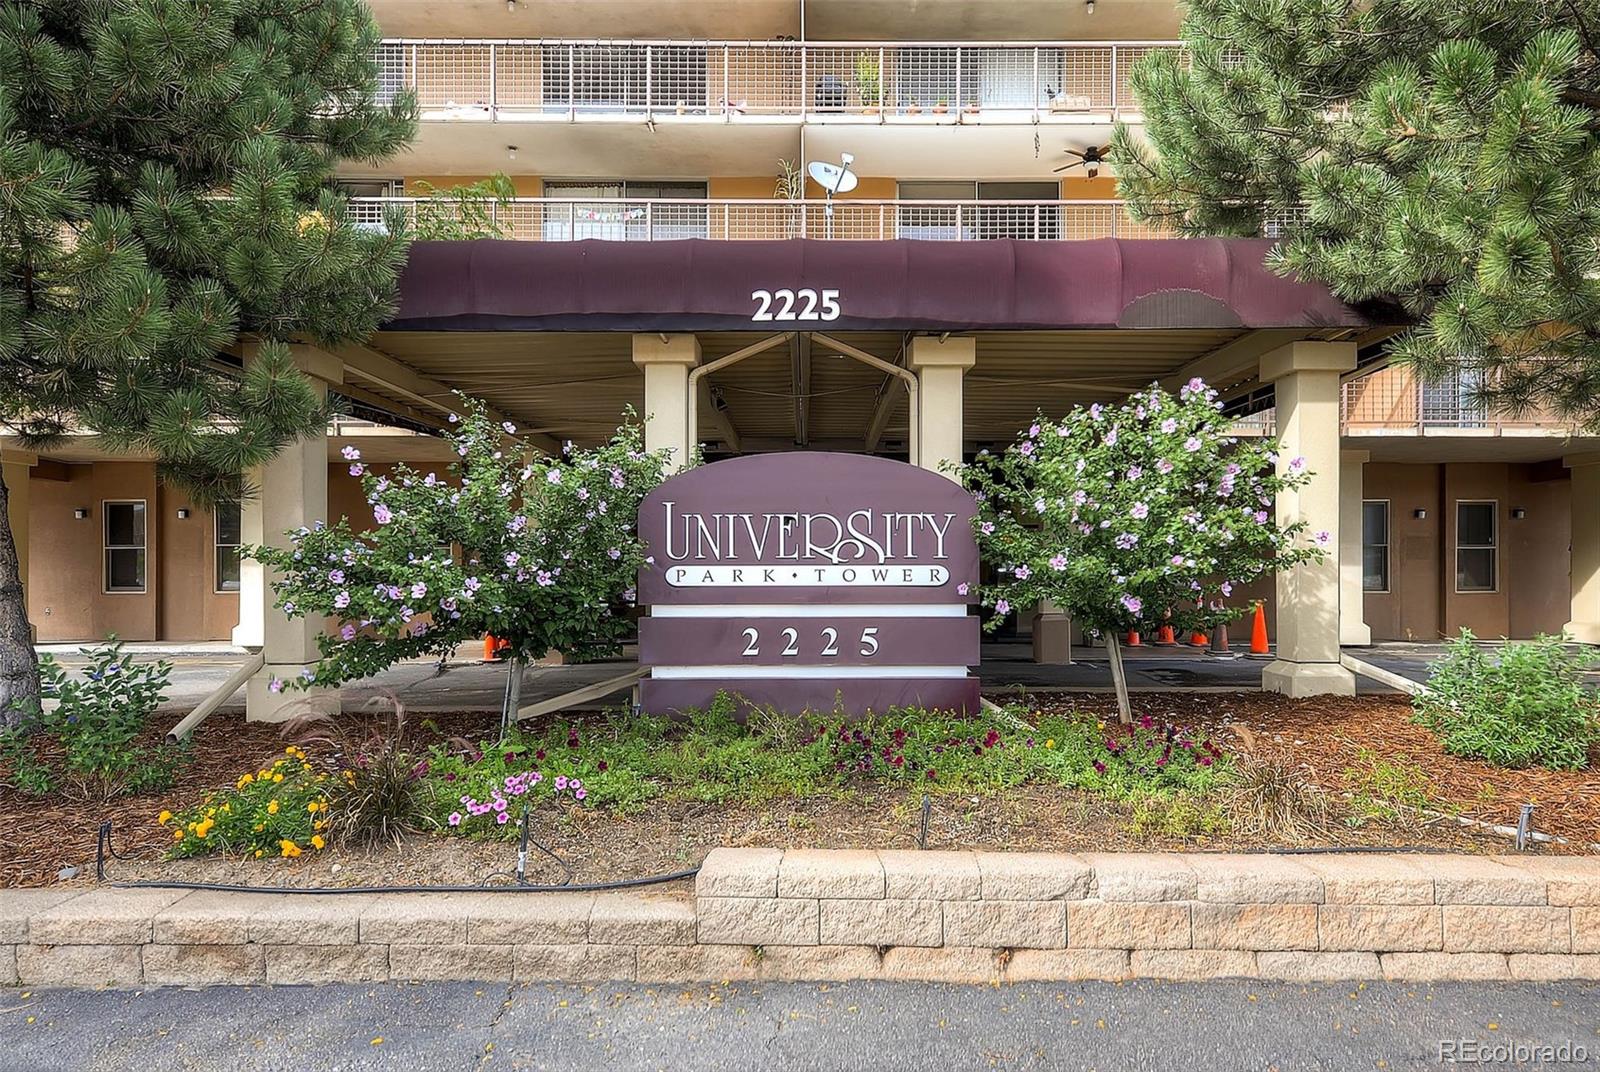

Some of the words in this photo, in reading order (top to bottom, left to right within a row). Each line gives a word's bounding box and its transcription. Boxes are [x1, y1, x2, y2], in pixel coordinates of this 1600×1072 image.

[751, 288, 841, 321] 2225
[662, 501, 957, 565] UNIVERSITY
[676, 568, 776, 583] PARK
[815, 568, 942, 583] TOWER
